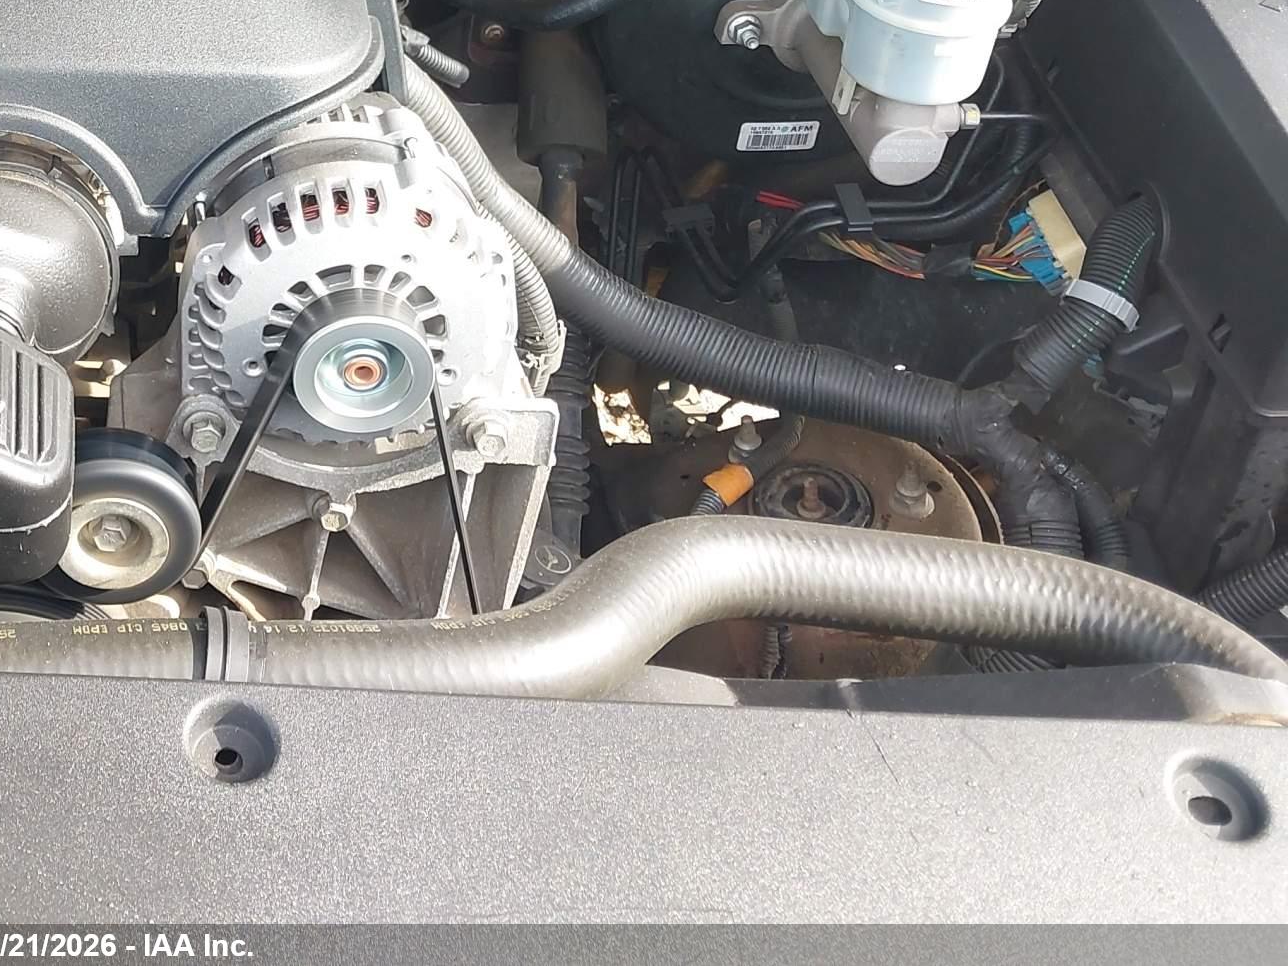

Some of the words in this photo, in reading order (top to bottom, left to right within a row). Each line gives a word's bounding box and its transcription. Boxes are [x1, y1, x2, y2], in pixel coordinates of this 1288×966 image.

[790, 124, 814, 133] AFM
[71, 622, 108, 635] EPDM
[116, 621, 143, 633] CIP
